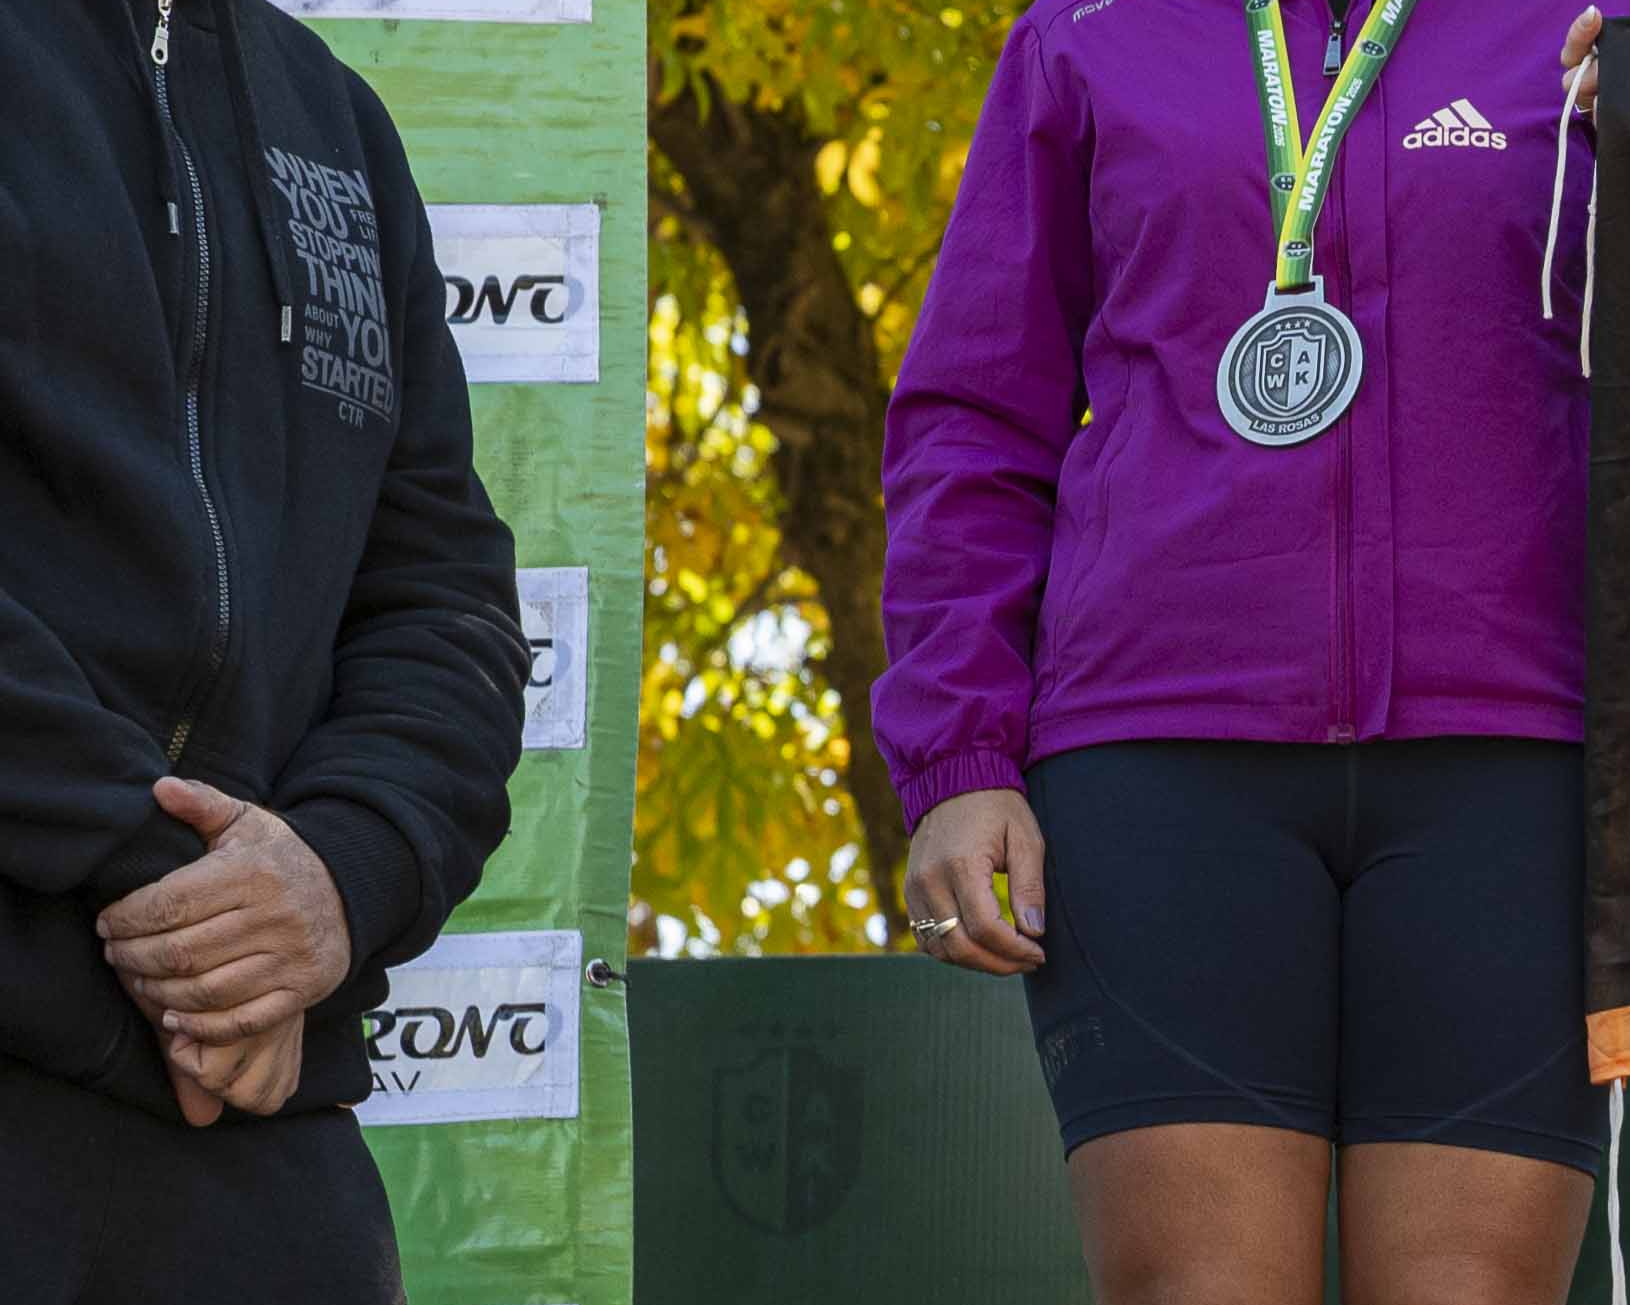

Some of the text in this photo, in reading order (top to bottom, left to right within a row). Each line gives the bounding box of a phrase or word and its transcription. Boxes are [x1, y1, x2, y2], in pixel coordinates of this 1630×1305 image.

[1257, 29, 1287, 126] MARATON
[1402, 126, 1507, 150] adidas
[1299, 95, 1352, 211] MARATON
[264, 147, 374, 209] WHEN
[272, 178, 348, 240] YOU
[304, 303, 340, 329] ABOUT
[304, 326, 333, 349] WHY
[1270, 351, 1311, 368] C A
[301, 346, 394, 414] STARTED
[1267, 370, 1310, 389] W K
[1252, 413, 1320, 433] LAS ROSAS
